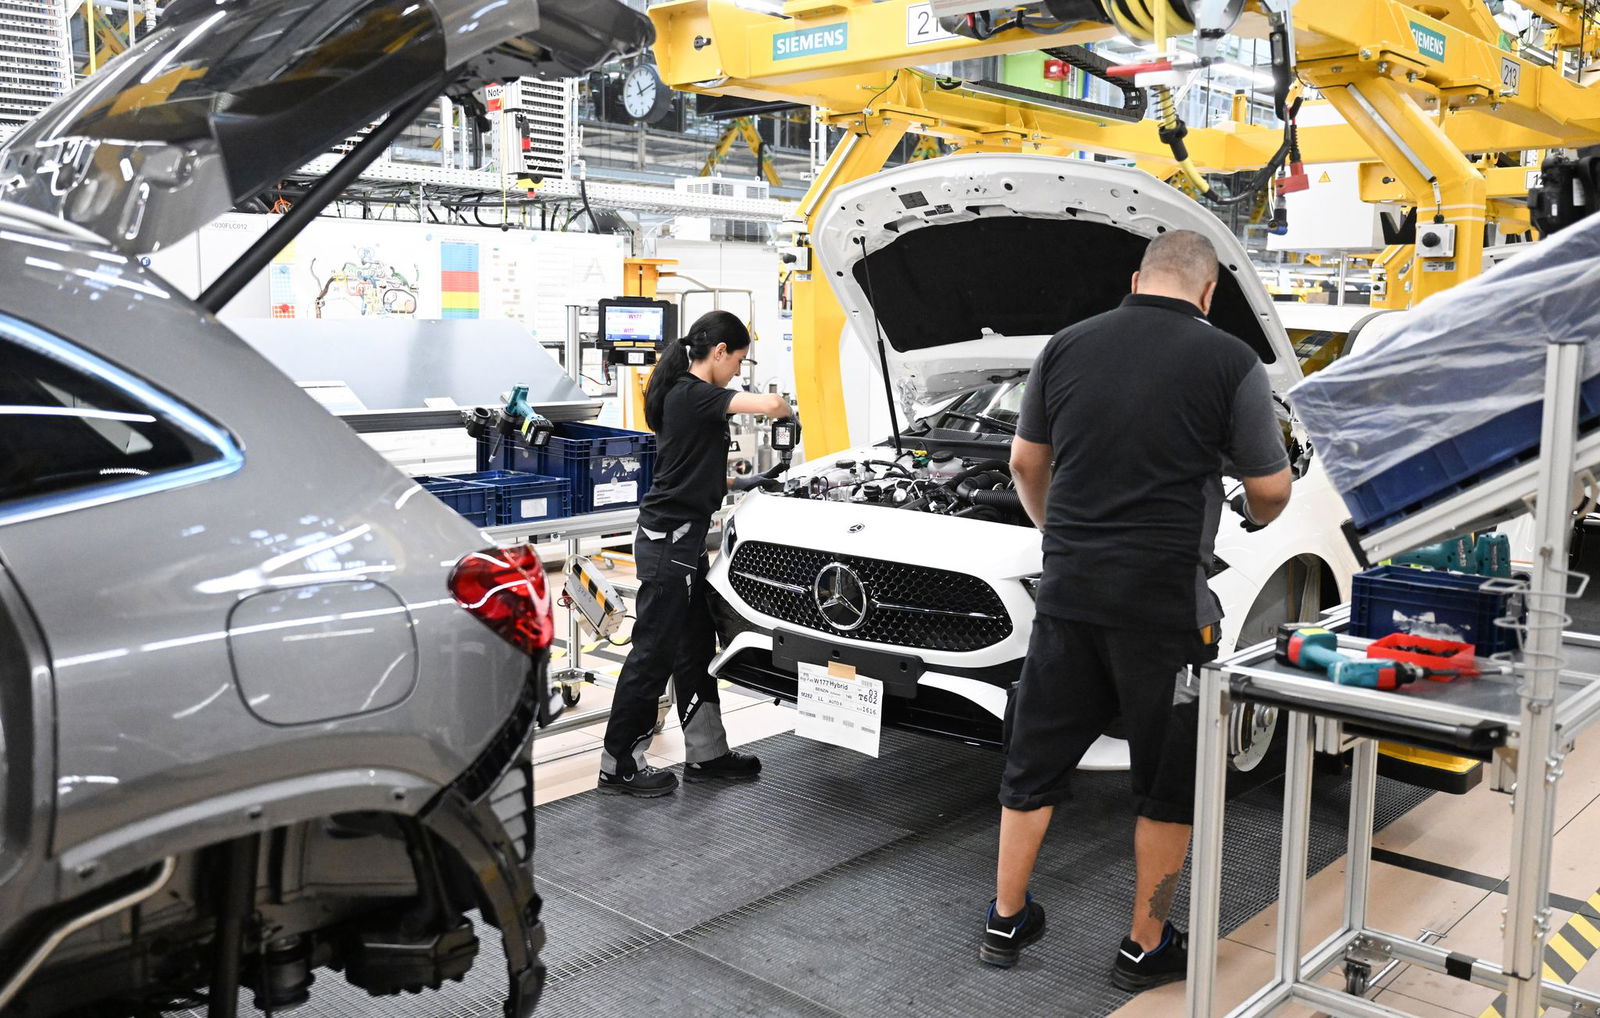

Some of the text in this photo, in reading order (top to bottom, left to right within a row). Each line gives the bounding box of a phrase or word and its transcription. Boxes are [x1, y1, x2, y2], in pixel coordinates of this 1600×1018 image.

[917, 11, 940, 35] 21
[776, 29, 844, 55] SIEMENS
[1503, 64, 1517, 89] 213
[830, 682, 848, 691] Hybrid
